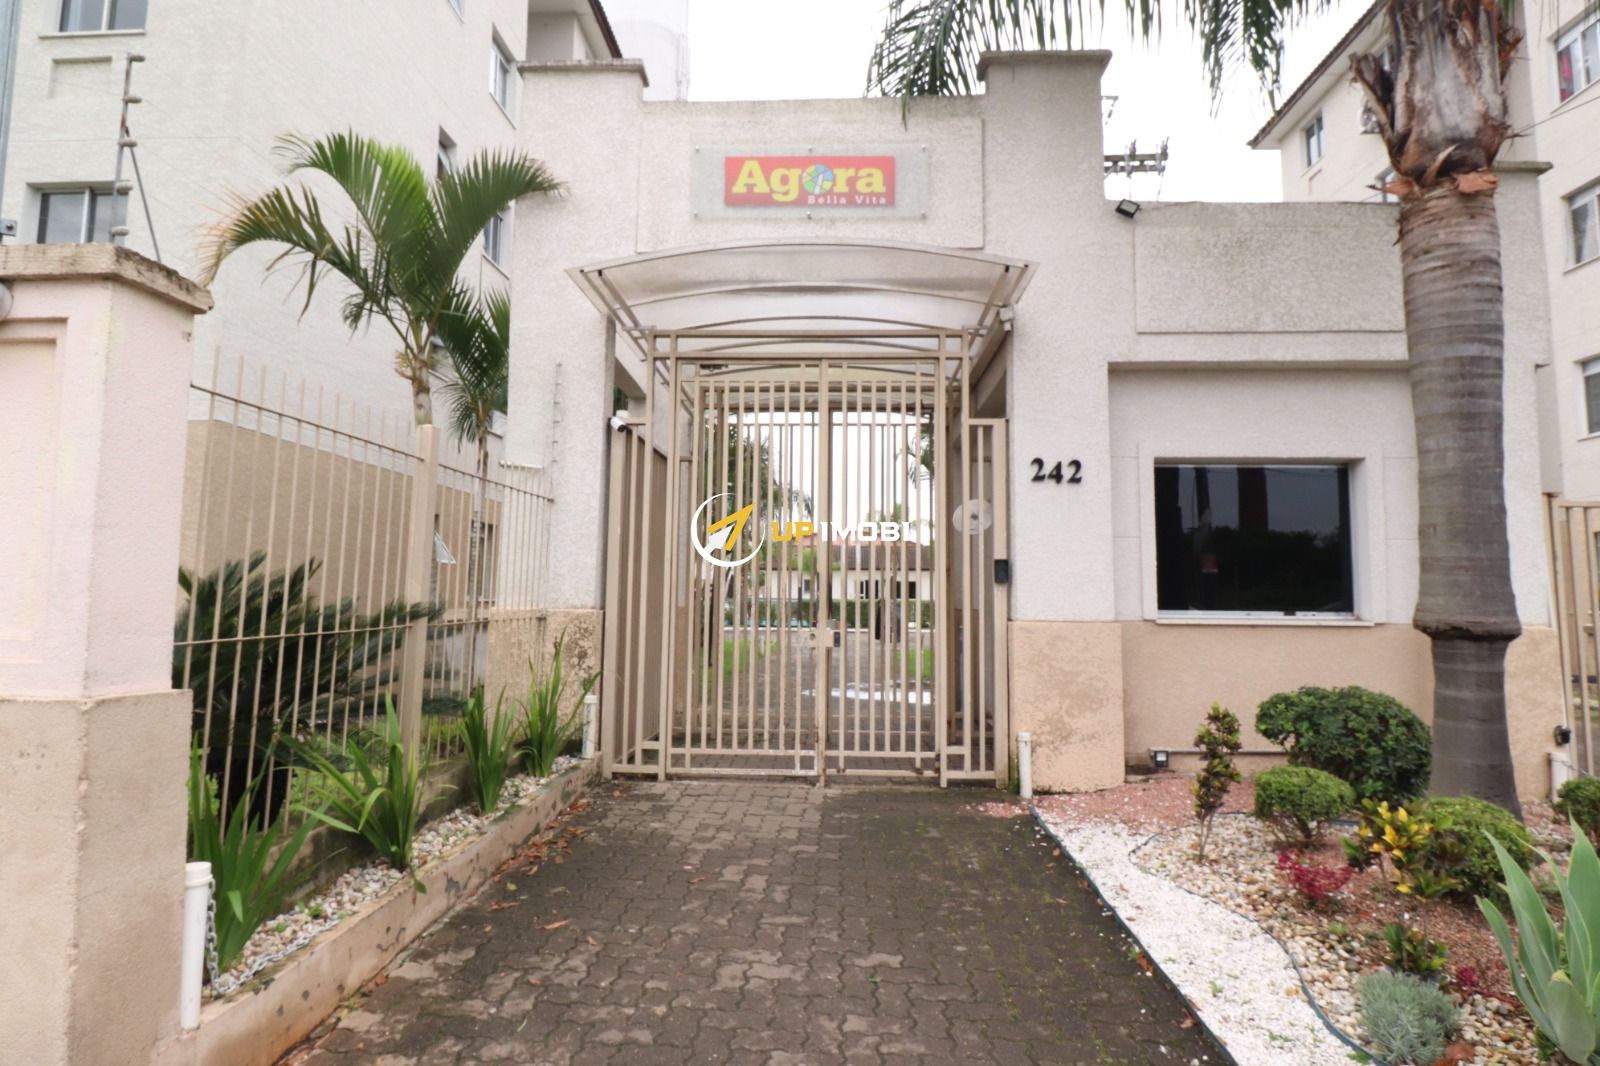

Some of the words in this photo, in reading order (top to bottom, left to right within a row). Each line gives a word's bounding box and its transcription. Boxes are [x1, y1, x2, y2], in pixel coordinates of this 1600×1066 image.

[731, 159, 887, 202] Agora
[807, 194, 848, 205] Bella
[854, 194, 887, 205] Vita
[1030, 457, 1082, 485] 242
